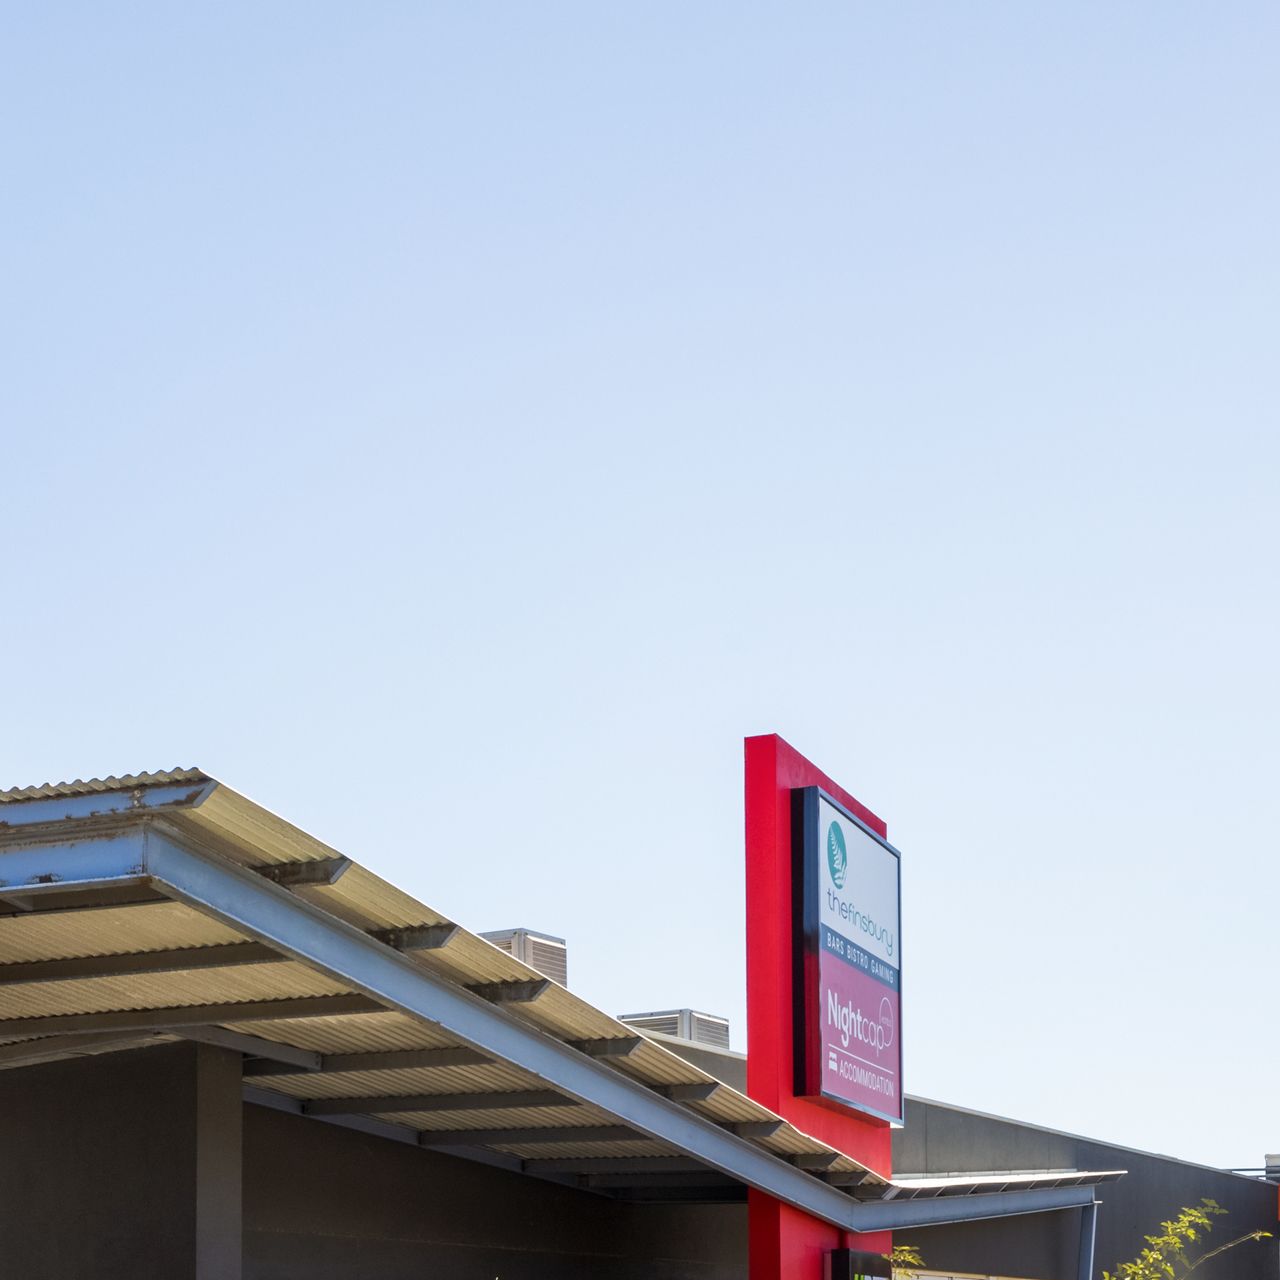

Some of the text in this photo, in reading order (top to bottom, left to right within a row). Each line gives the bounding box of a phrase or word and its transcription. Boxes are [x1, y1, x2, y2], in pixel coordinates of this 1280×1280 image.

[827, 888, 893, 957] thefinsbury
[827, 932, 894, 984] BARS BISTRO GAMING
[827, 989, 885, 1057] Nightcap
[839, 1059, 894, 1097] ACCOMMODATION
